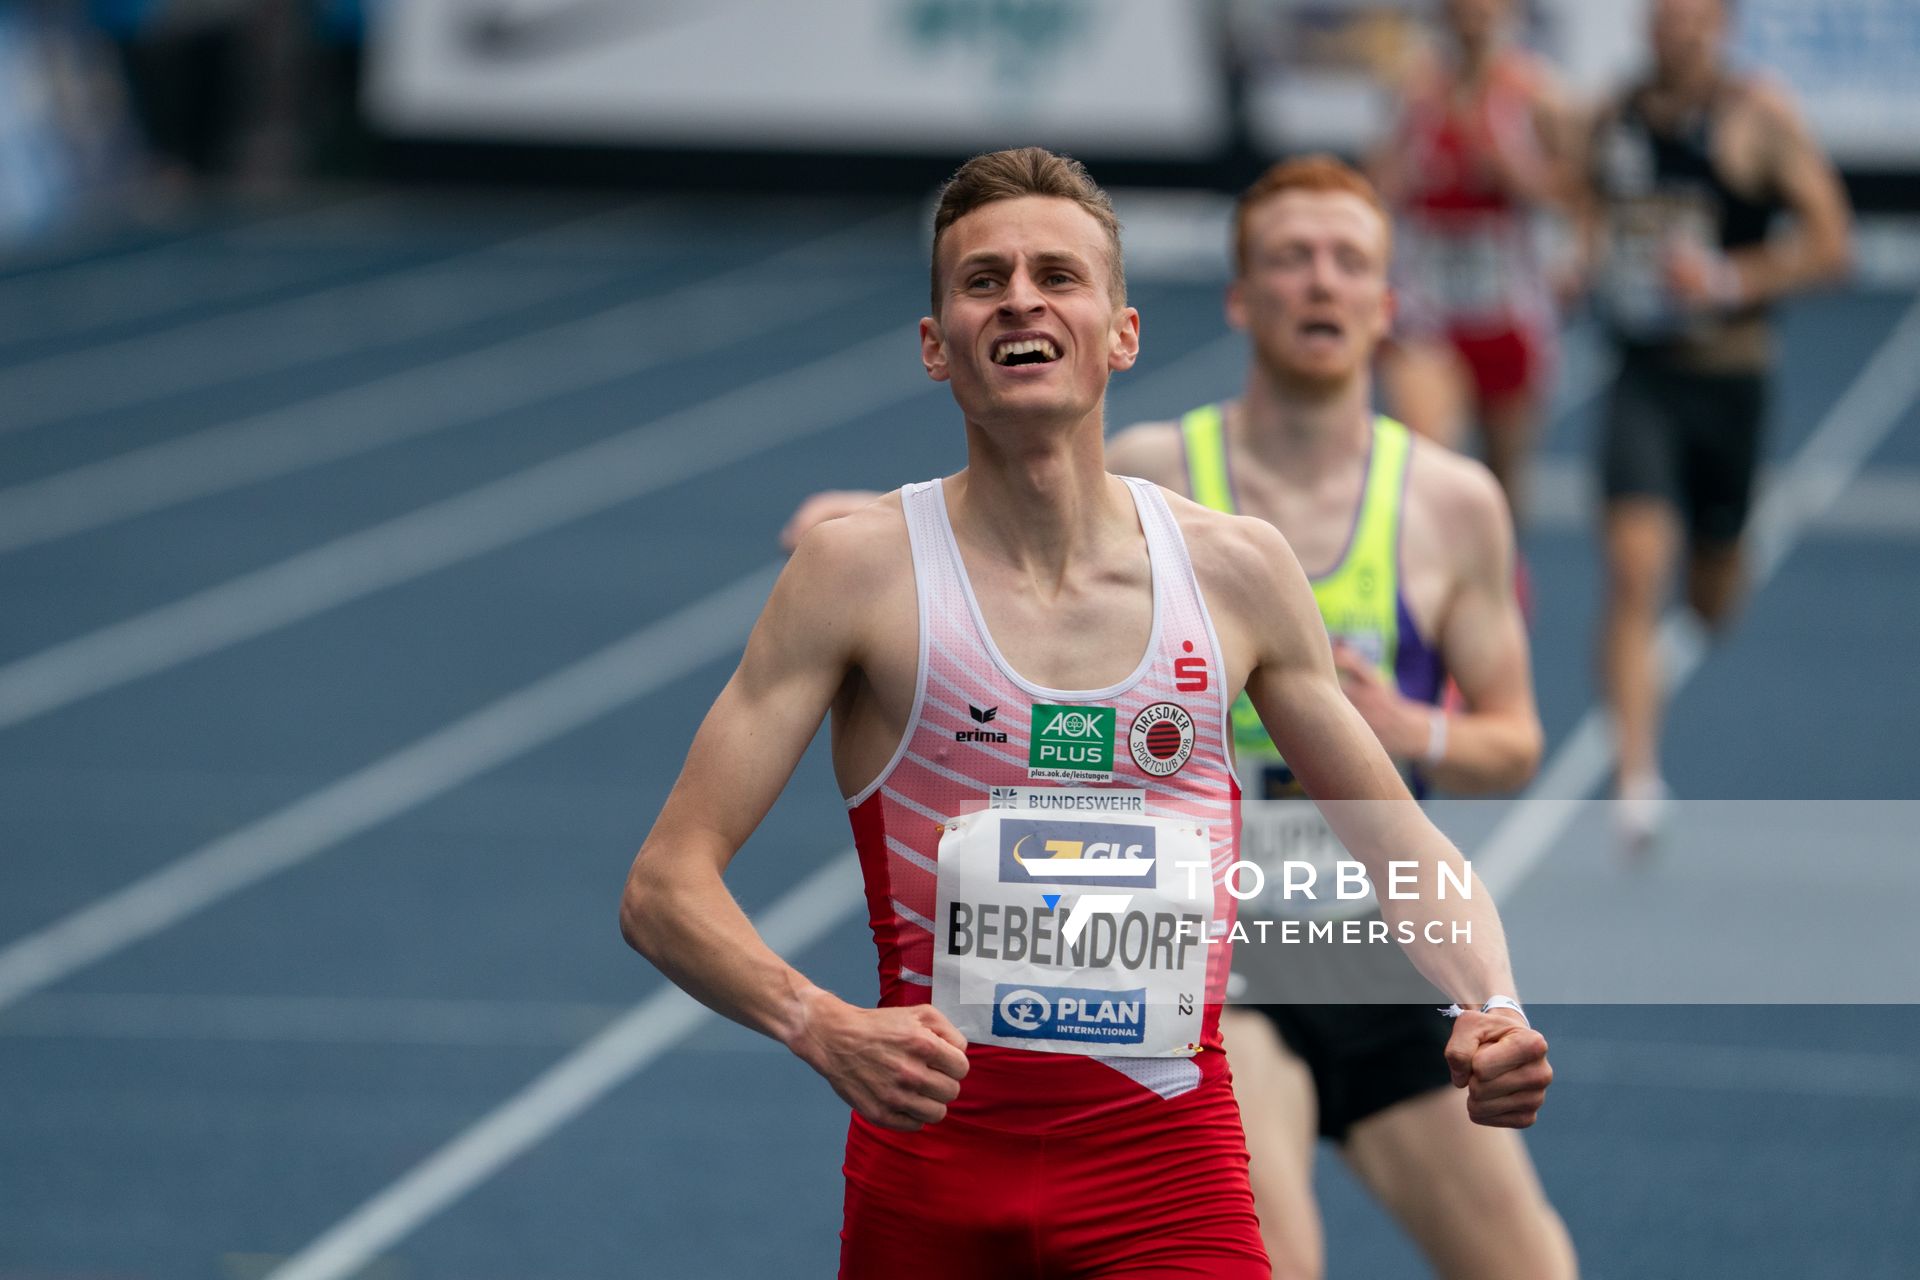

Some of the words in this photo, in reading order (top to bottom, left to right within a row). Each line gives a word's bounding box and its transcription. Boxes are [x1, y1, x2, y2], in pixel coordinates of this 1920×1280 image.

[1041, 712, 1104, 739] AOK
[1135, 706, 1190, 734] DRESDNER
[955, 728, 1007, 743] erima
[1040, 745, 1103, 764] PLUS
[1133, 741, 1178, 773] SPORTCLUB
[1177, 738, 1191, 761] 1898
[1030, 769, 1109, 782] plus.aok.de/leistungen
[1028, 794, 1142, 812] BUNDESWEHR
[948, 901, 1203, 971] BEBENDORF
[1057, 997, 1140, 1024] PLAN
[1178, 993, 1194, 1016] 22
[1057, 1025, 1138, 1037] INTERNATIONAL
